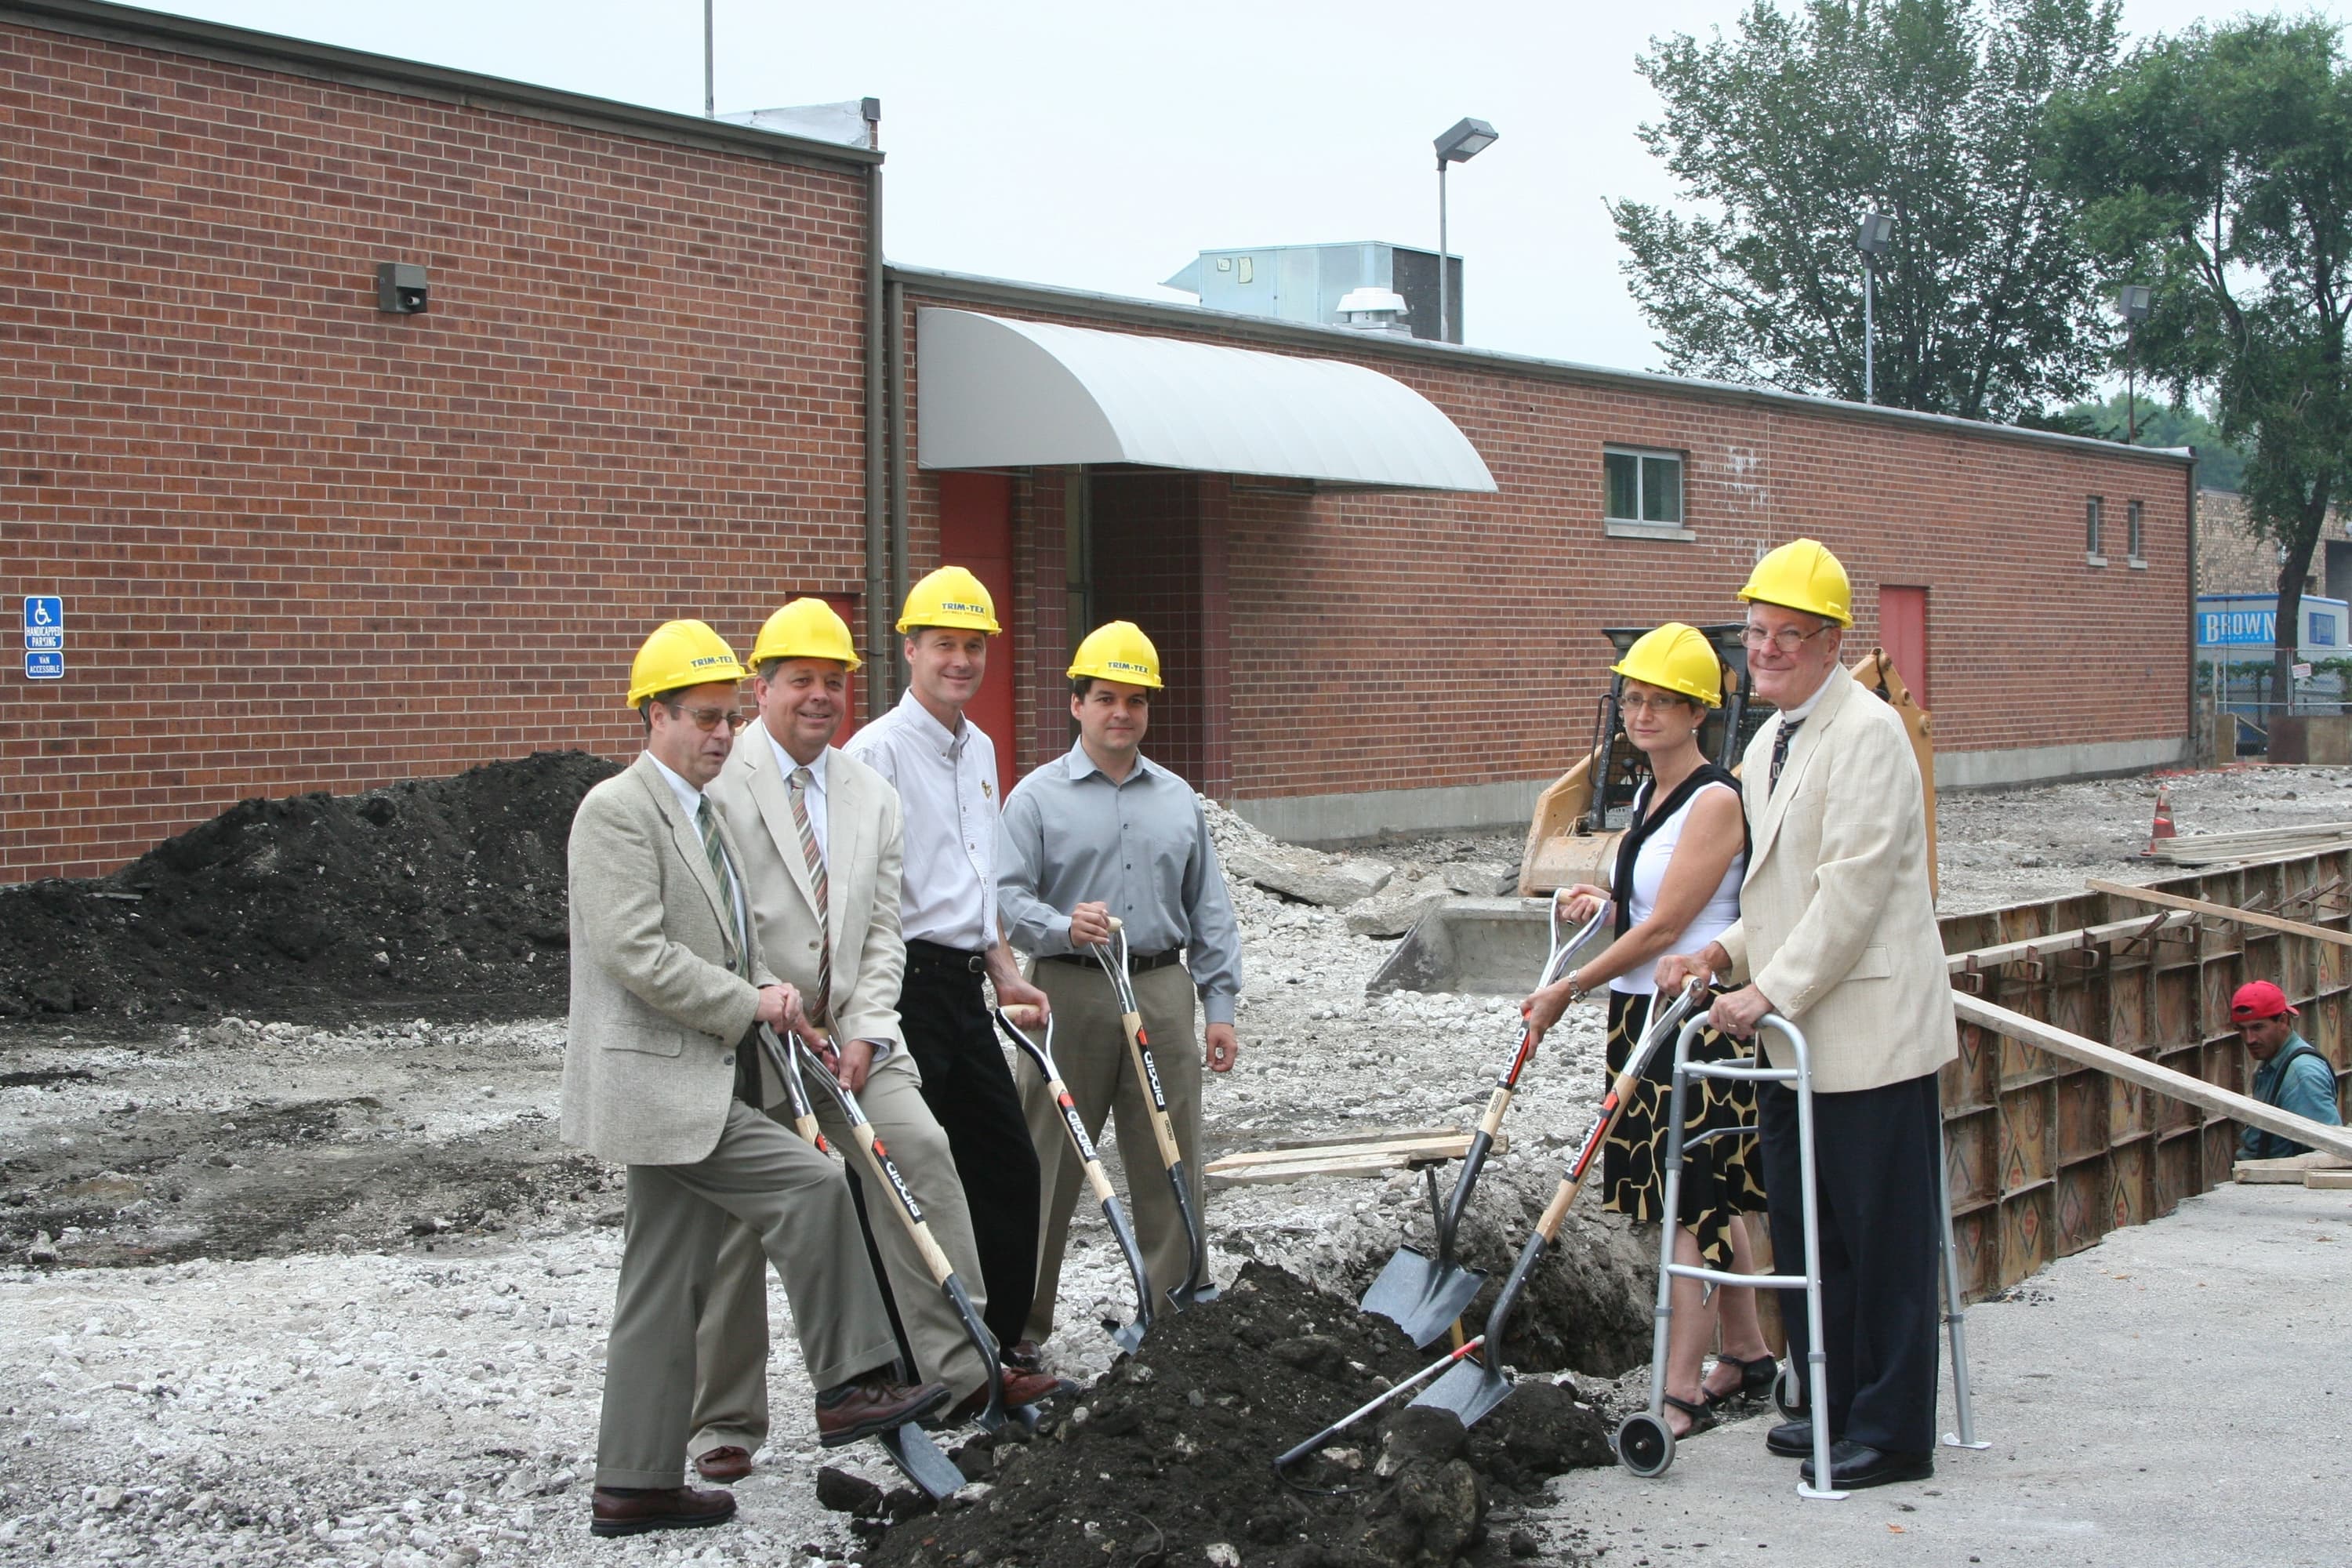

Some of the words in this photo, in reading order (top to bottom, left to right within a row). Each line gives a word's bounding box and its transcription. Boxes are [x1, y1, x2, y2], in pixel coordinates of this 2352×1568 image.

[942, 603, 985, 614] TRIM-TEX
[2206, 612, 2277, 642] BROWN
[31, 637, 56, 647] PARKING
[1108, 662, 1149, 673] TRIM-TEX
[1498, 1027, 1526, 1083] RIDGID
[1144, 1051, 1166, 1106] RIDGID
[1067, 1110, 1098, 1157] RIDGID
[886, 1161, 921, 1218] RIDGID
